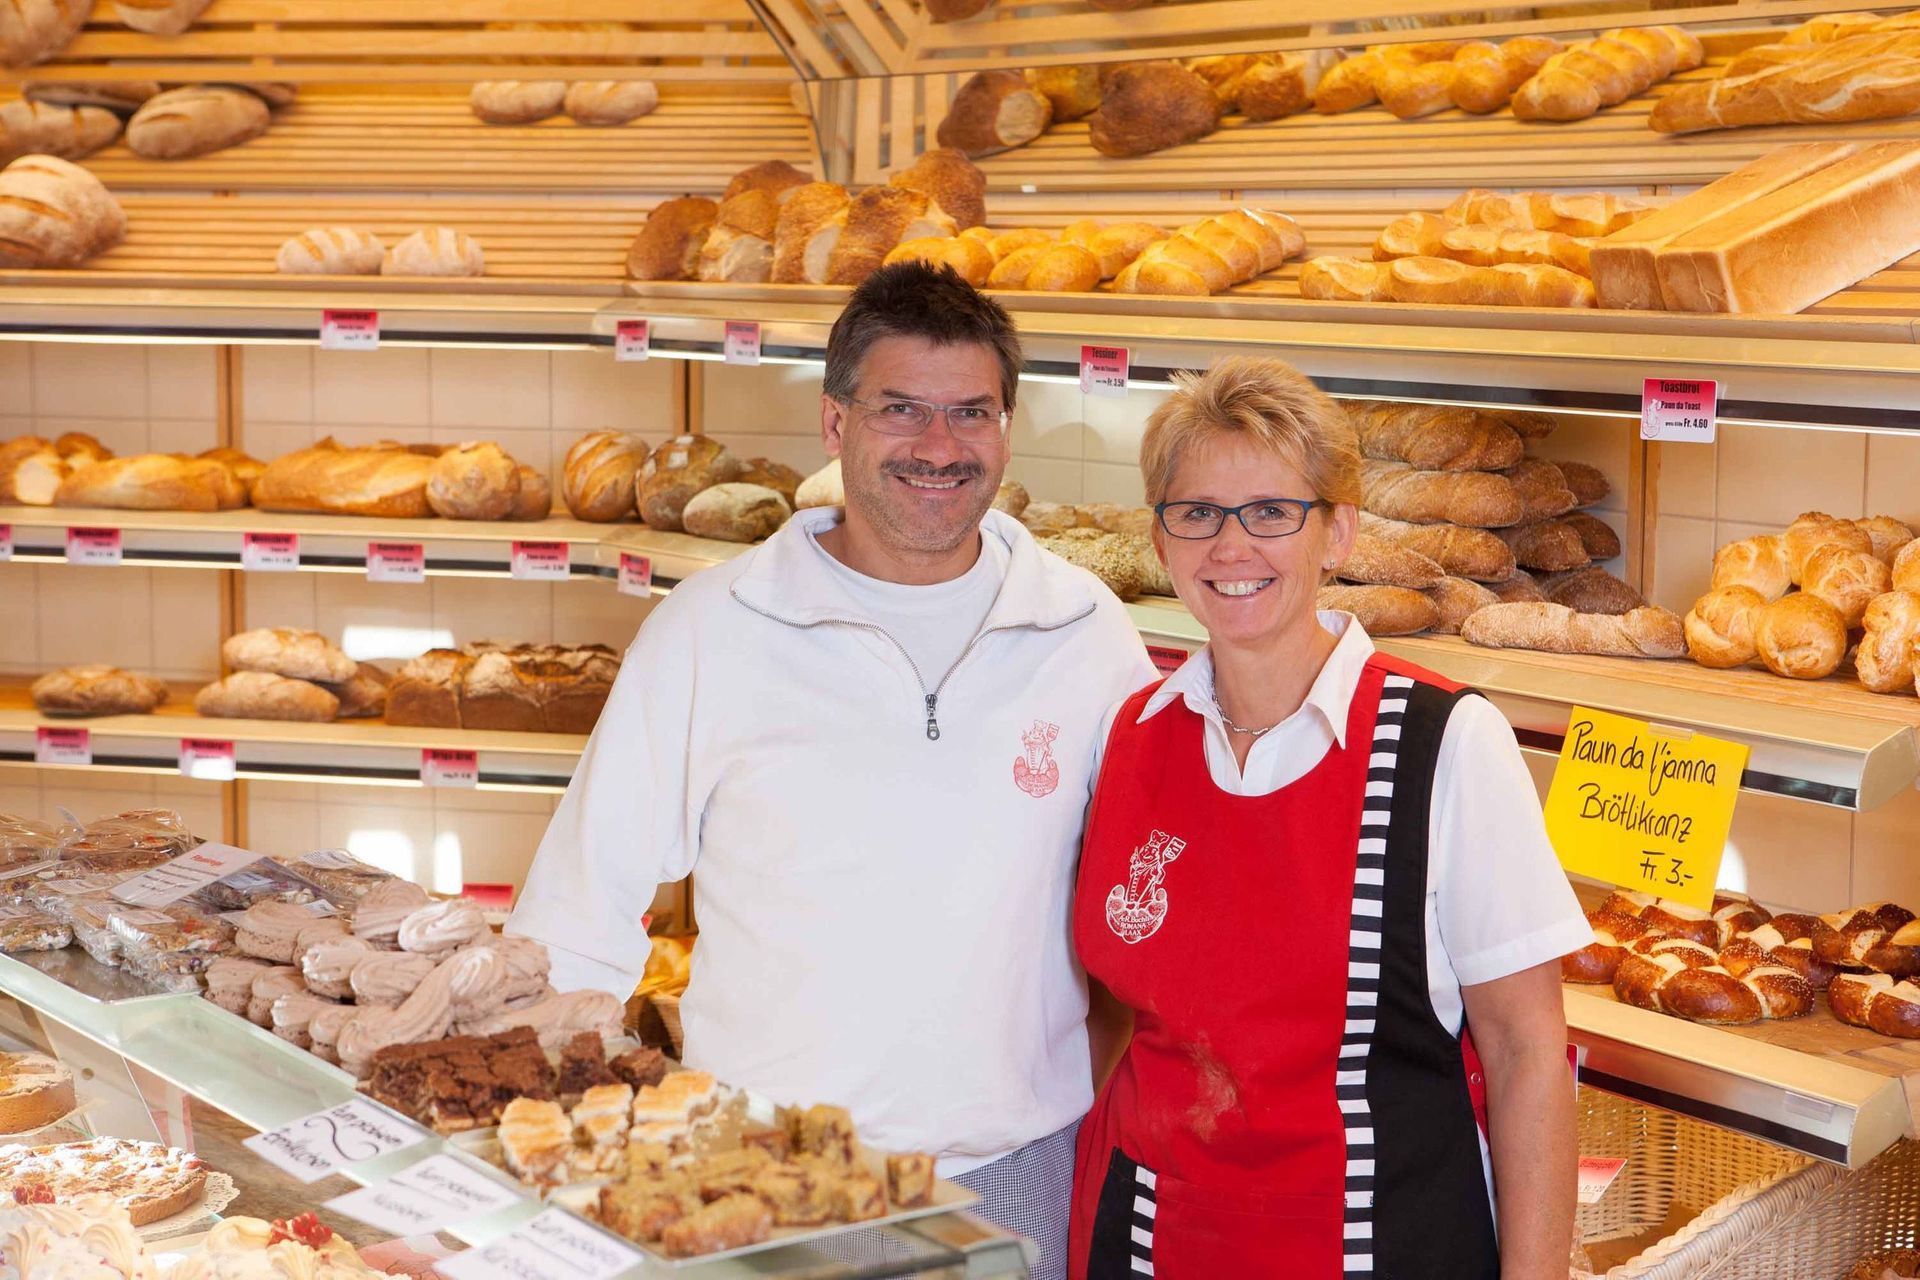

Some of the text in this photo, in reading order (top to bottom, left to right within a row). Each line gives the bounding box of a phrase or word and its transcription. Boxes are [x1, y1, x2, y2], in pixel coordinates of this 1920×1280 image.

[1660, 381, 1700, 394] Toastbrot
[1685, 402, 1701, 410] Toast
[1684, 418, 1692, 428] Fr.
[1693, 418, 1708, 429] 4.60
[1572, 721, 1617, 765] Paun
[1620, 736, 1644, 769] da
[1578, 782, 1693, 843] Brötlikranz
